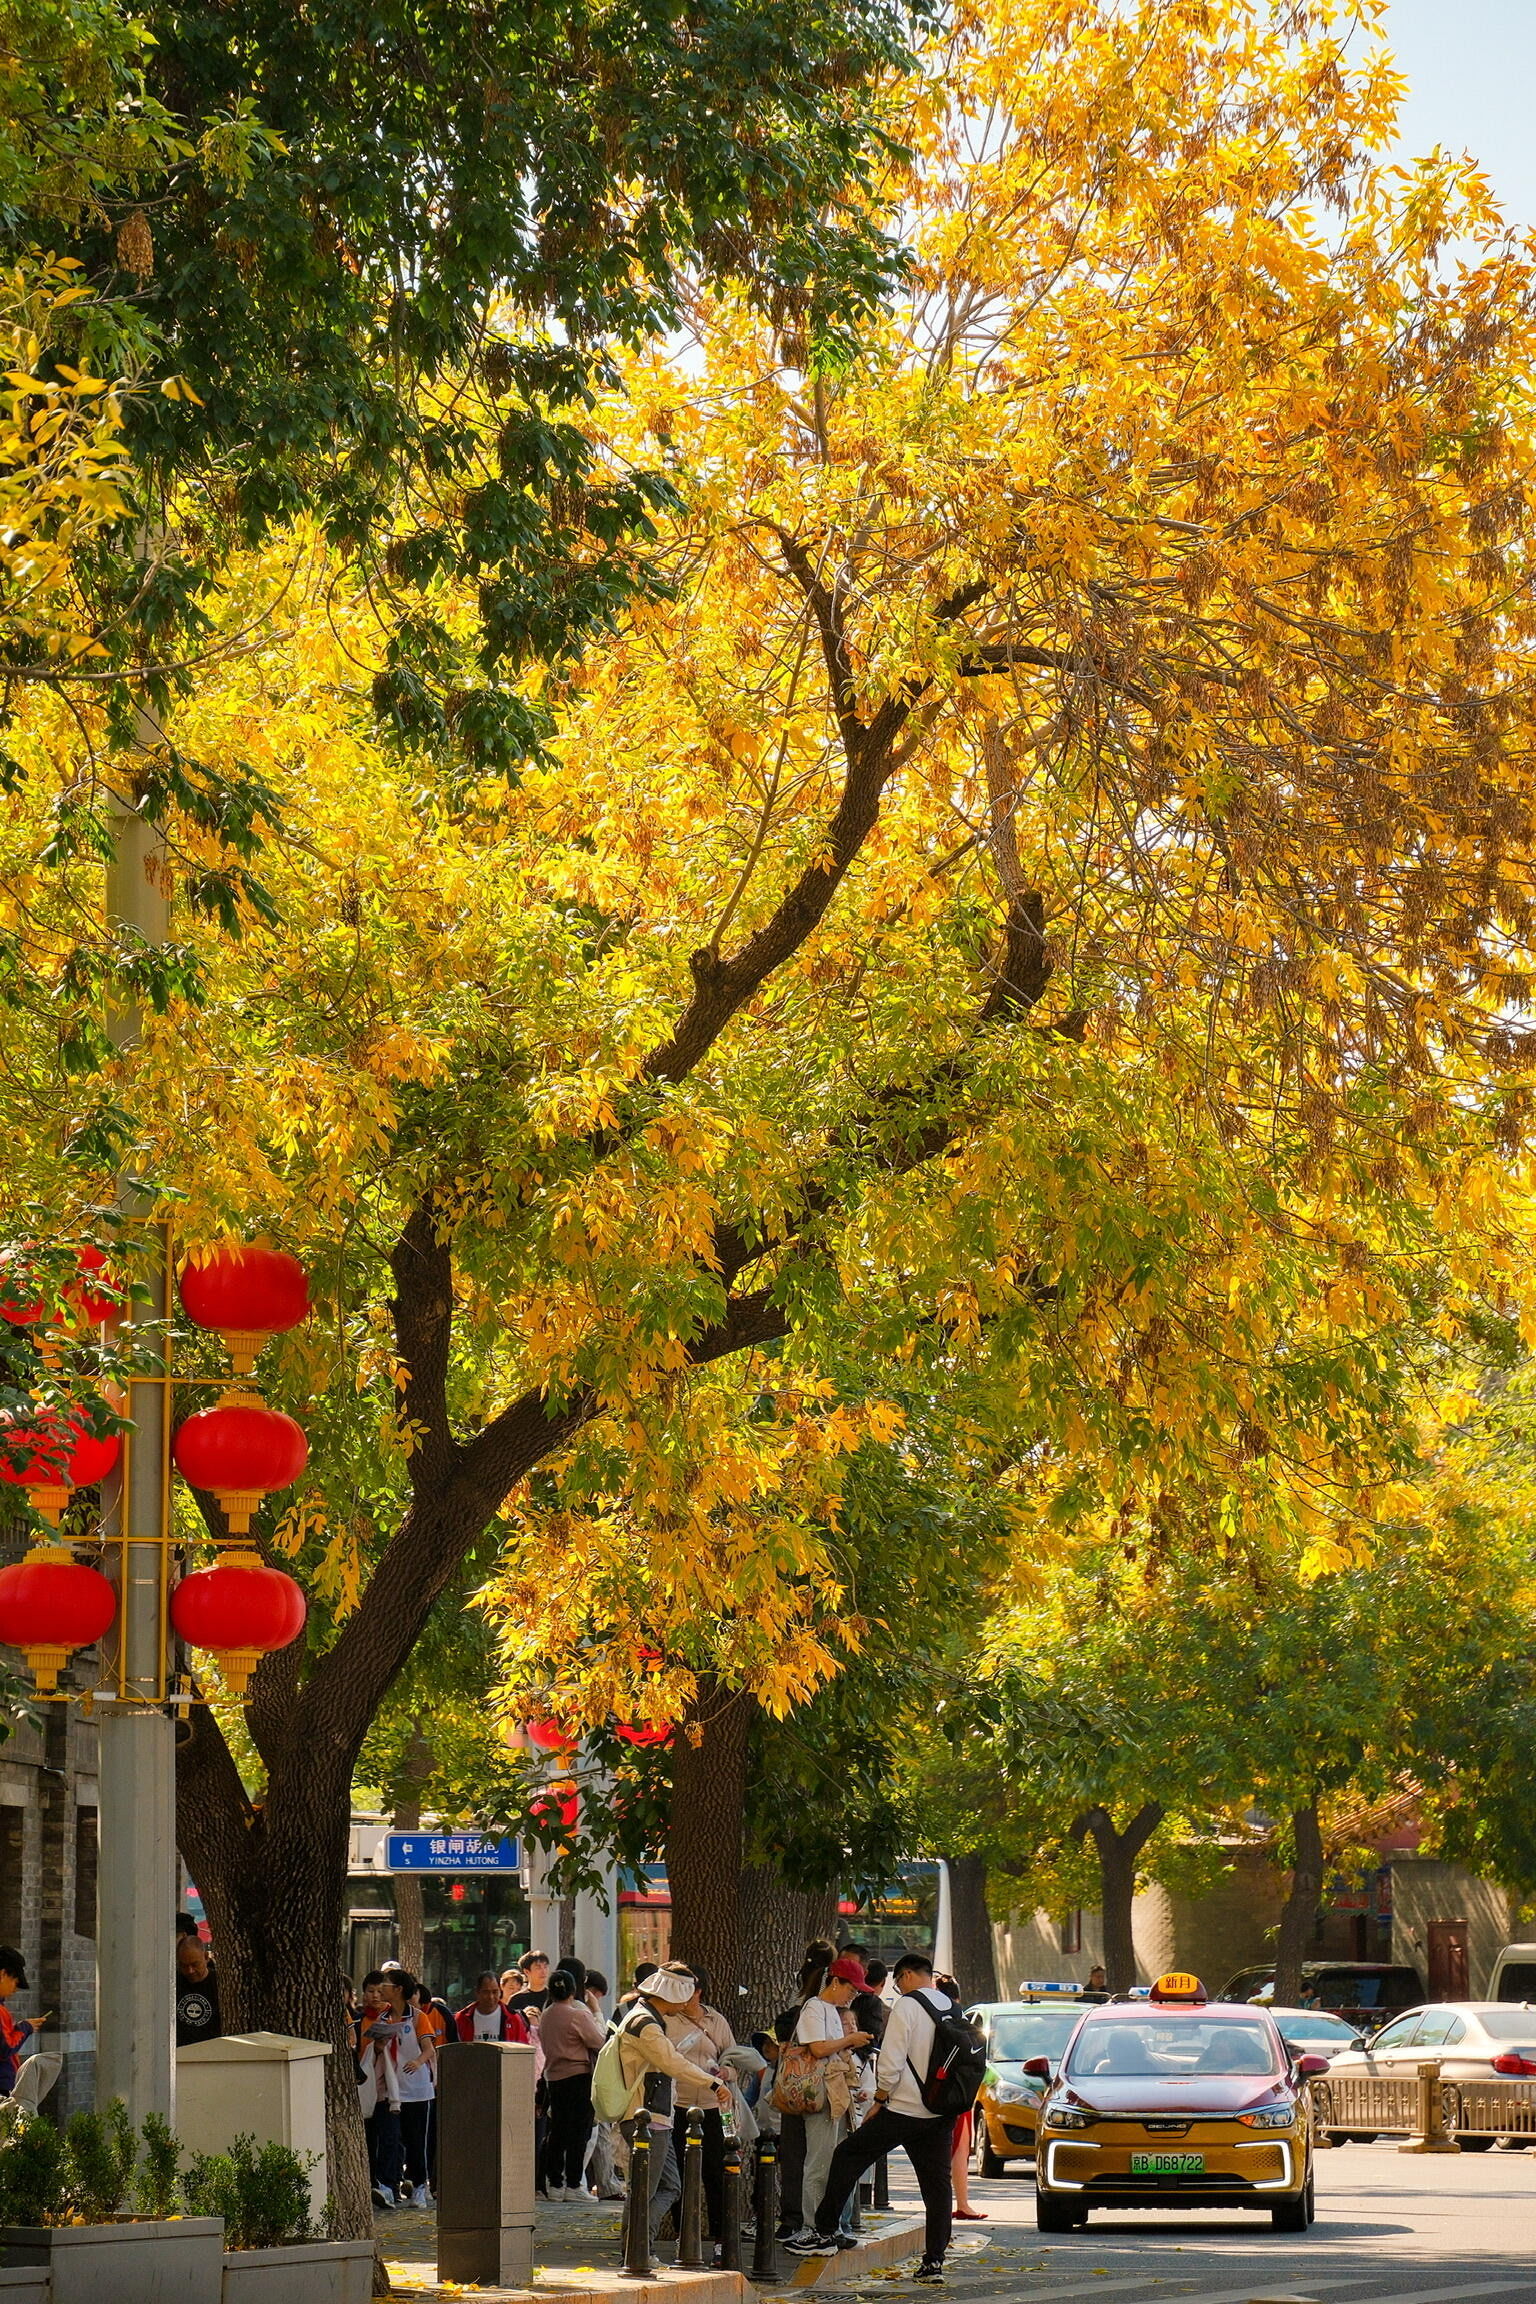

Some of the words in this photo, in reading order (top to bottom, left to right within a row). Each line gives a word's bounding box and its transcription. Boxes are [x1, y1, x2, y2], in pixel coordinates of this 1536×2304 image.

[429, 1857, 461, 1865] YINZHA
[465, 1857, 500, 1865] HUTONG
[1165, 1976, 1191, 1989] 新月
